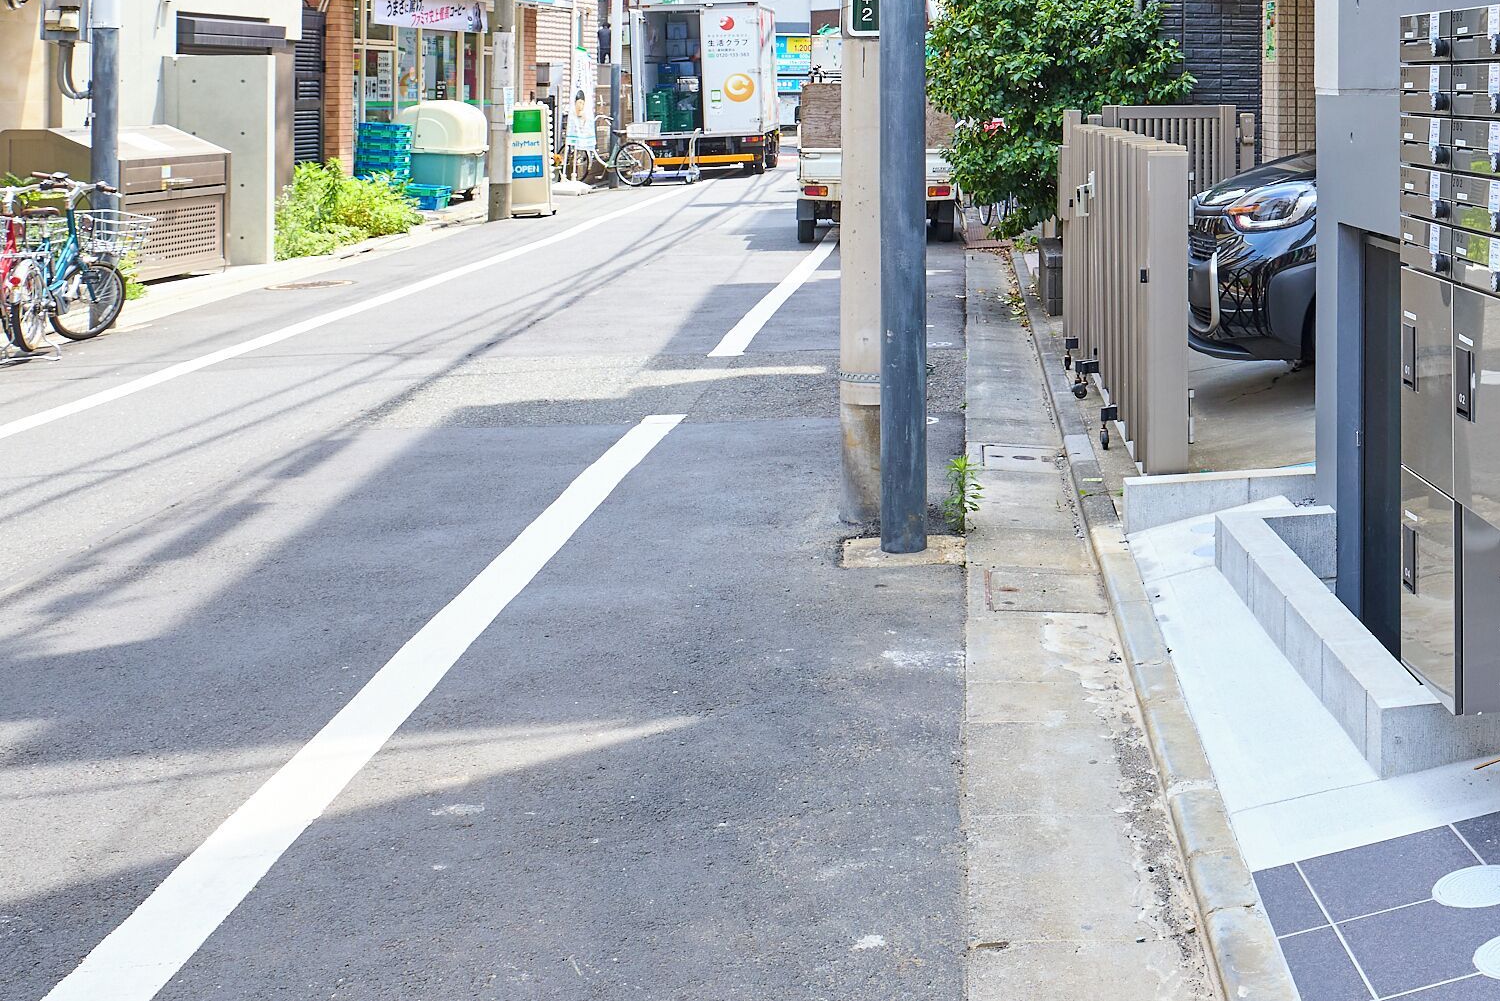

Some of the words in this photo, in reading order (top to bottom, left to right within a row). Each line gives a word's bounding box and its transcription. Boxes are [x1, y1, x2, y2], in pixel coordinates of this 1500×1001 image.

[1452, 68, 1463, 77] 402
[1453, 122, 1463, 132] 302
[514, 164, 540, 174] OPEN
[1452, 178, 1463, 188] 202
[1458, 393, 1466, 405] 02
